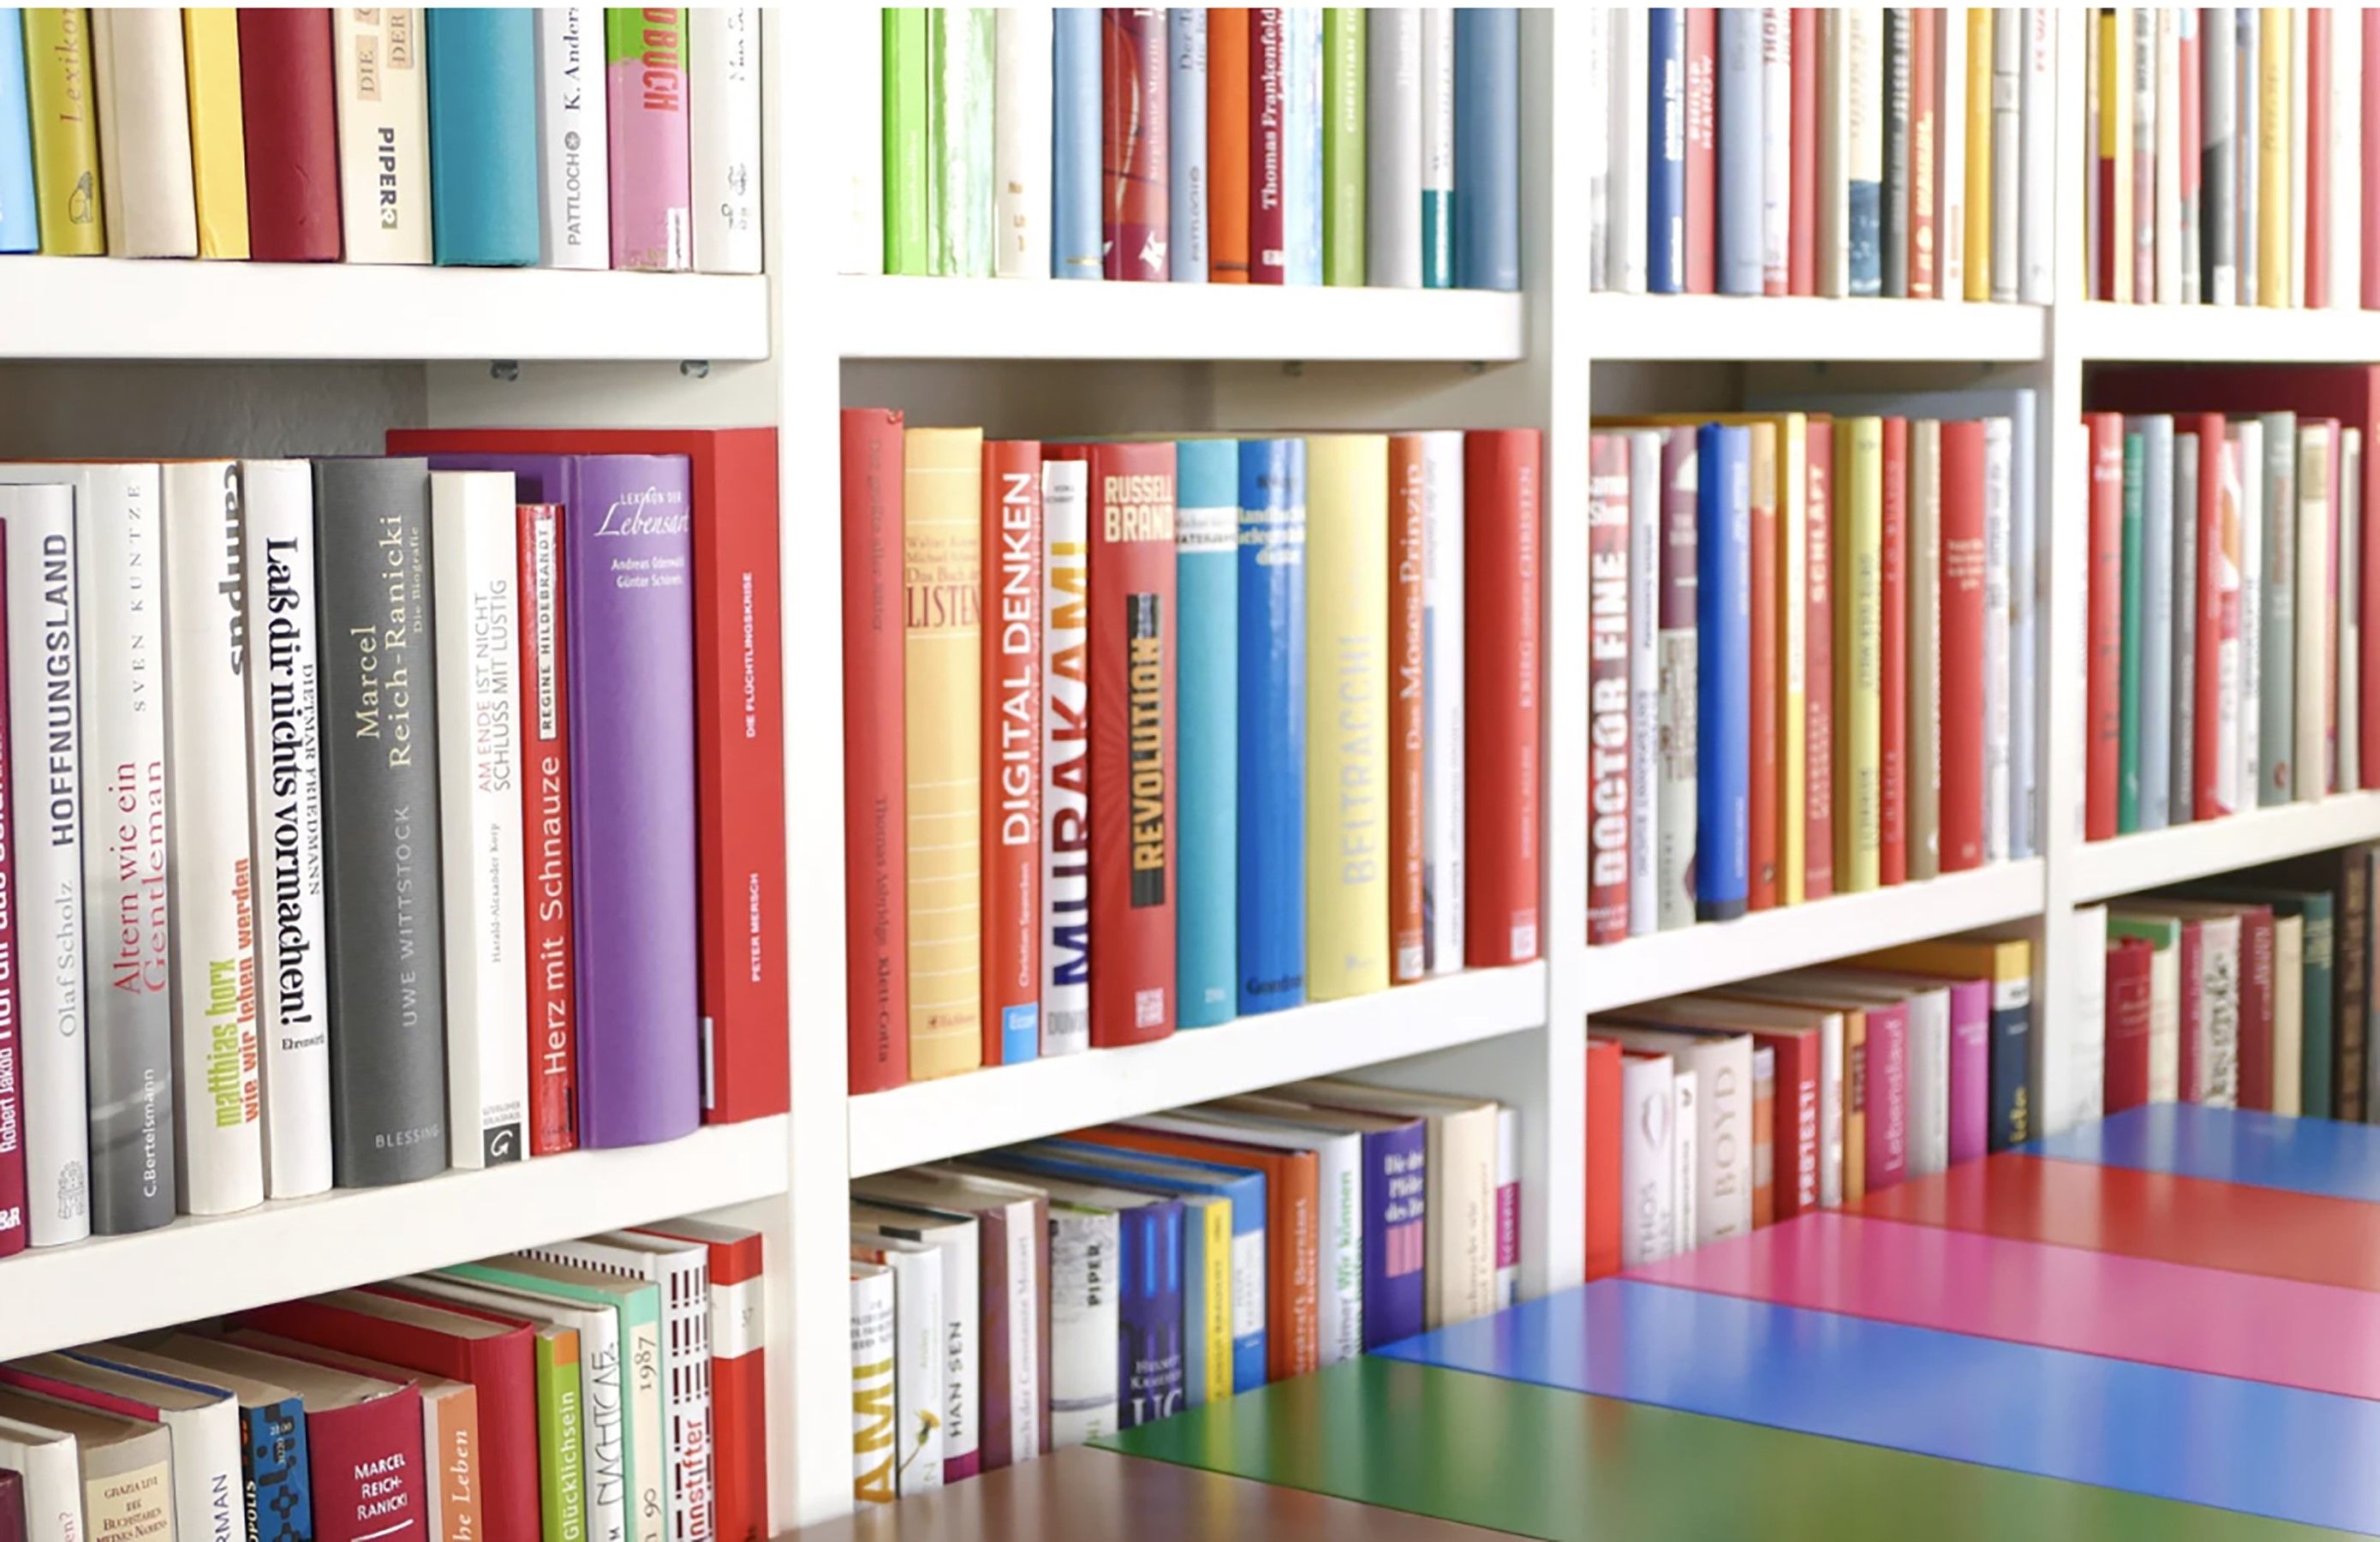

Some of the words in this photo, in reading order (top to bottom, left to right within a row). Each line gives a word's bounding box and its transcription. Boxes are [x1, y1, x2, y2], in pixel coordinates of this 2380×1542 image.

[357, 50, 375, 93] DIE
[391, 14, 407, 63] DER
[564, 87, 581, 111] K.
[1345, 39, 1357, 133] CHRISTIAN
[378, 127, 397, 206] PIPER
[565, 153, 582, 246] PATTLOCH
[1261, 130, 1279, 211] Thomas
[594, 486, 691, 537] Lebensart
[1104, 474, 1173, 504] RUSSELL
[1104, 504, 1174, 543] BRAND
[128, 484, 144, 613] KUNTZE
[265, 537, 301, 612] Laß
[1002, 473, 1032, 654] DENKEN
[474, 592, 490, 658] NICHT
[490, 579, 509, 658] LUSTIG
[538, 529, 552, 656] HILDEBRANDT
[1592, 551, 1628, 661] FINE
[131, 635, 146, 713] SVEN
[267, 613, 301, 675] dir
[379, 514, 412, 768] Reich-Ranicki
[475, 662, 491, 695] IST
[491, 660, 510, 696] MIT
[44, 534, 75, 848] HOFFNUNGSLAND
[301, 665, 319, 760] DIETMAR
[349, 625, 381, 739] Marcel
[540, 665, 553, 732] REGINE
[270, 684, 305, 798] nichts
[477, 702, 492, 756] ENDE
[492, 699, 511, 792] SCHLUSS
[746, 715, 756, 738] DIE
[1002, 666, 1032, 846] DIGITAL
[1052, 541, 1089, 986] MURAKAMI
[1130, 637, 1166, 872] REVOLUTION
[108, 762, 138, 810] ein
[478, 762, 492, 793] AM
[1591, 677, 1628, 888] DOCTOR
[110, 825, 138, 883] wie
[305, 768, 321, 896] FRIEDMANN
[537, 755, 564, 922] Schnauze
[141, 760, 168, 993] Gentleman
[231, 858, 252, 951] werden
[395, 805, 415, 959] WITTSTOCK
[749, 872, 759, 934] MERSCH
[56, 880, 75, 971] Scholz
[113, 893, 141, 995] Altern
[273, 803, 313, 1027] vormachen!
[204, 959, 237, 1018] horx
[236, 956, 255, 1023] leben
[540, 935, 566, 992] mit
[751, 937, 761, 983] PETER
[57, 977, 75, 1037] Olaf
[401, 971, 418, 1028] UWE
[206, 1023, 244, 1128] matthias
[240, 1031, 258, 1077] wir
[542, 1001, 568, 1076] Herz
[143, 1068, 157, 1199] C.Bertelsmann
[239, 1080, 259, 1123] wie
[374, 1123, 440, 1150] BLESSING
[1713, 1066, 1737, 1198] BOYD
[1086, 1242, 1102, 1307] PIPER
[635, 1336, 657, 1392] 1987
[353, 1452, 407, 1480] MARCEL
[361, 1475, 403, 1500] REICH-
[450, 1428, 472, 1504] Leben
[557, 1390, 580, 1542] Glücklichsein
[645, 1487, 662, 1518] 90
[356, 1493, 409, 1521] RANICKI
